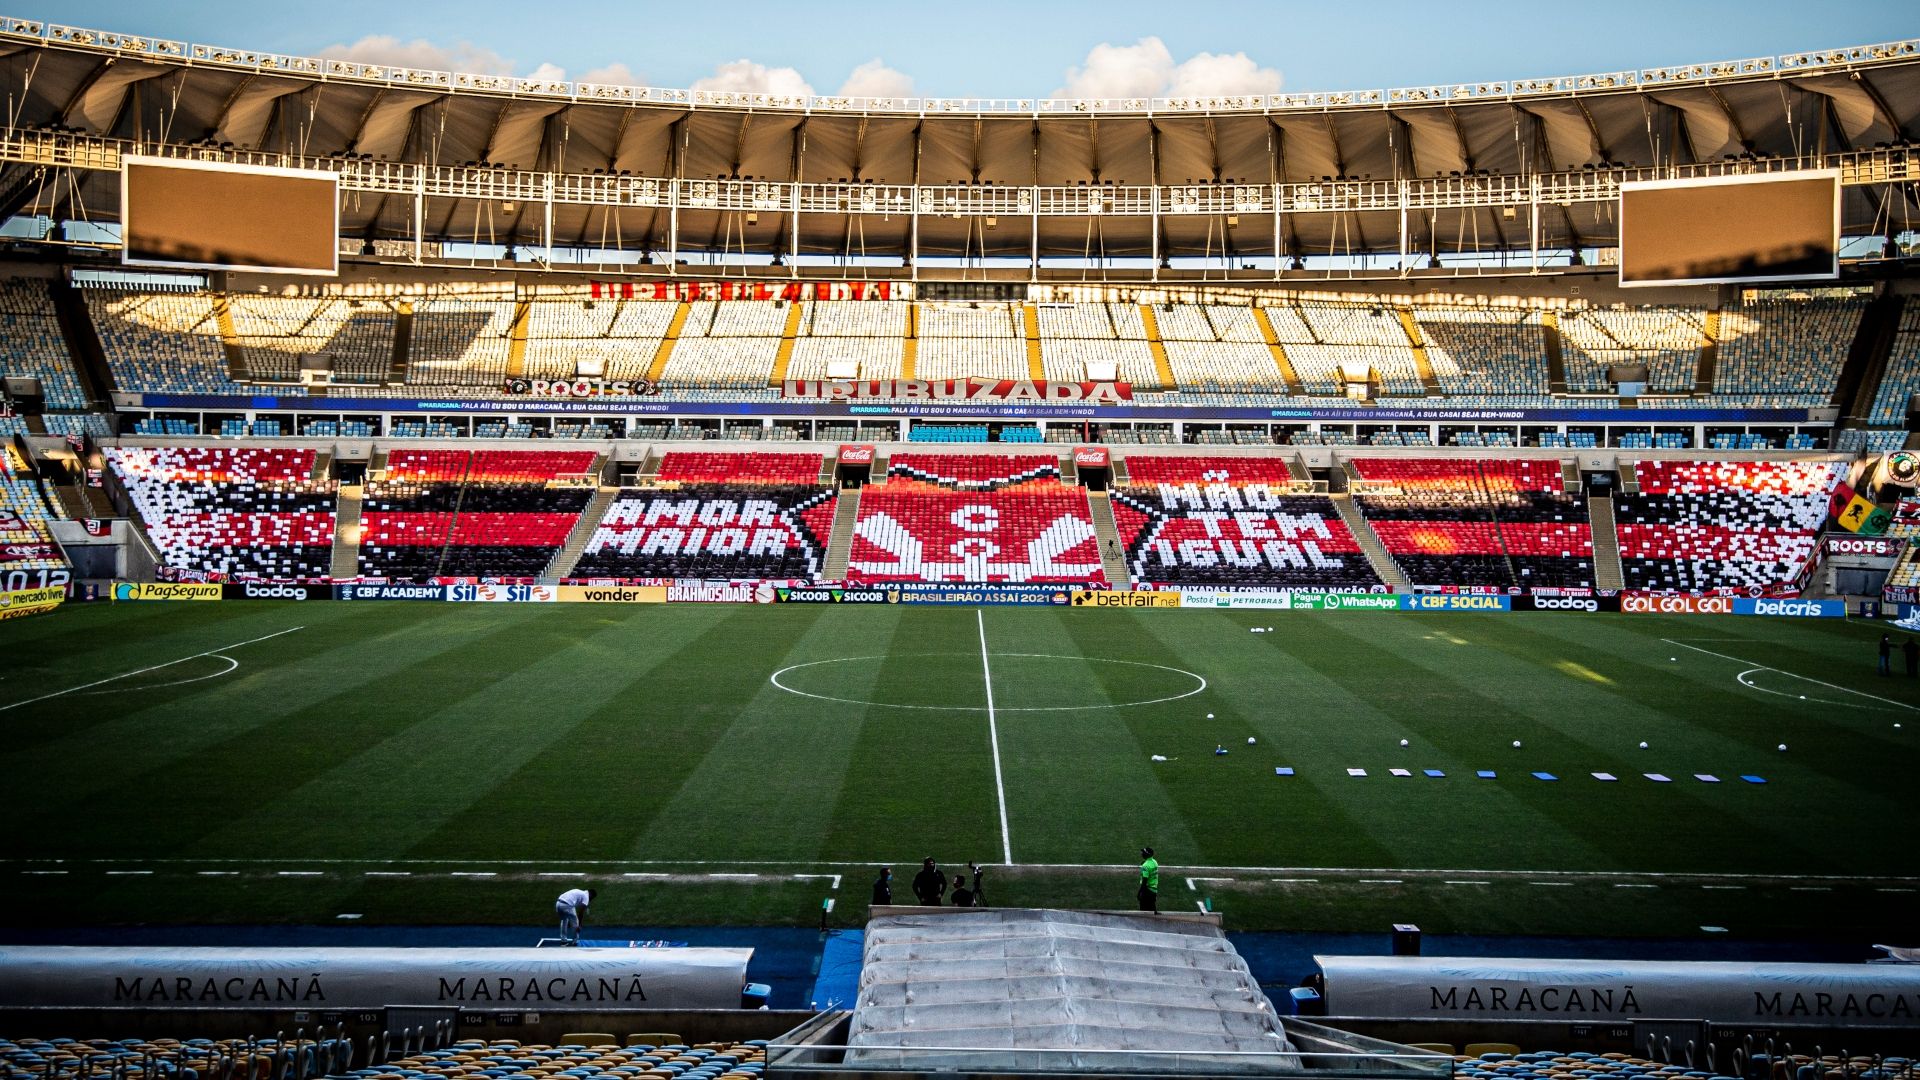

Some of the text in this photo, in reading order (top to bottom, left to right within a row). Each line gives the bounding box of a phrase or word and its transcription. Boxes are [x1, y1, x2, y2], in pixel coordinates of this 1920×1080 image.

[531, 380, 630, 396] ROOTS
[784, 376, 1122, 402] URUBUZADA
[842, 450, 872, 460] Coca-Cola
[1076, 452, 1105, 462] Coca-Cola
[602, 498, 778, 526] AMOR
[1187, 512, 1332, 539] TEM
[585, 527, 789, 556] MAIOR
[1828, 540, 1886, 553] ROOTS
[1156, 540, 1344, 570] IGUAL
[13, 589, 63, 604] mercado livre
[145, 585, 218, 597] PagSeguro
[246, 584, 307, 600] bodog
[357, 587, 441, 598] CBF ACADEMY
[452, 586, 477, 601] Sil
[506, 586, 531, 601] Sil
[585, 588, 639, 601] vonder
[668, 587, 754, 602] BRAHMOSIDADE
[791, 590, 829, 600] SICOOB
[844, 592, 883, 601] SICOOB
[902, 591, 1050, 602] BRASILEIRÃO ASSAÍ 2021
[1294, 594, 1321, 602] Pague
[1885, 592, 1916, 603] FEIRA
[1342, 597, 1396, 609] WhatsApp
[1422, 596, 1502, 608] CBF SOCIAL
[1535, 595, 1597, 612] bodog
[1623, 598, 1732, 612] GOL GOL GOL
[1755, 599, 1822, 616] betcris
[114, 973, 326, 1001] MARACANÃ
[438, 973, 648, 1001] MARACANÃ
[1430, 986, 1642, 1013] MARACANÃ
[1754, 992, 1920, 1018] MARACA
